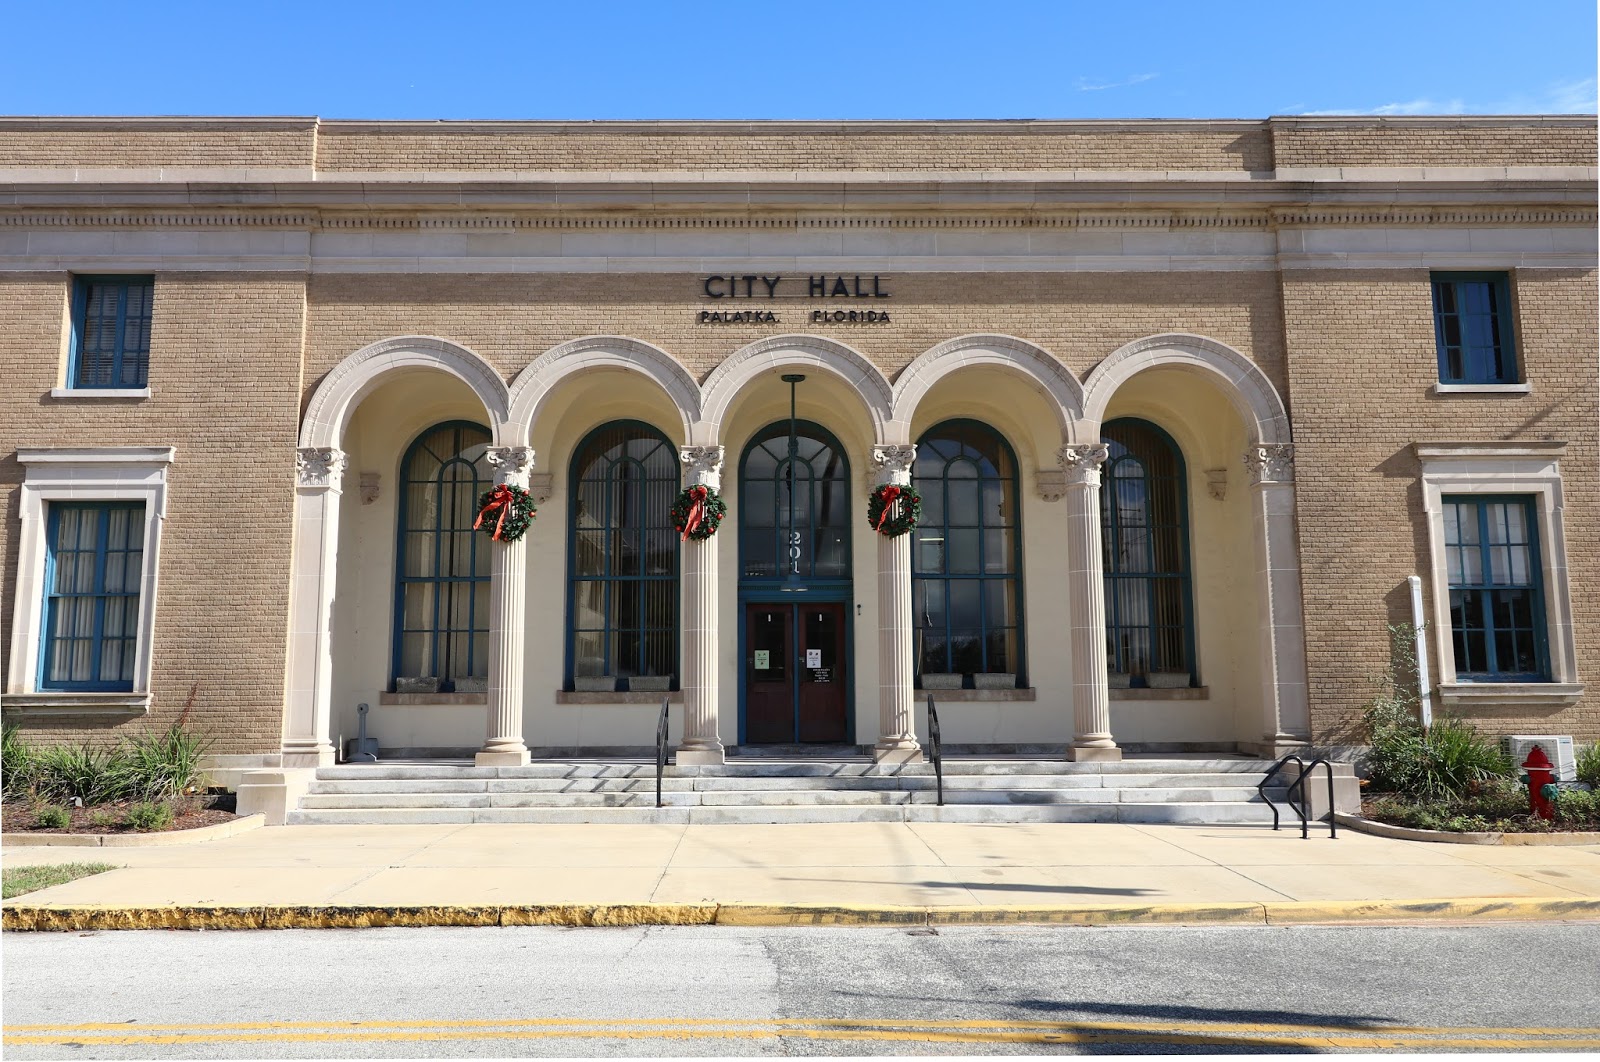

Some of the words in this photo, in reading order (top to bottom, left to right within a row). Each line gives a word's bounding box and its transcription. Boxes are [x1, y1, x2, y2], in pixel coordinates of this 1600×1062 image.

[704, 275, 781, 298] CITY
[809, 275, 889, 298] HALL
[813, 310, 891, 323] FLORIDA
